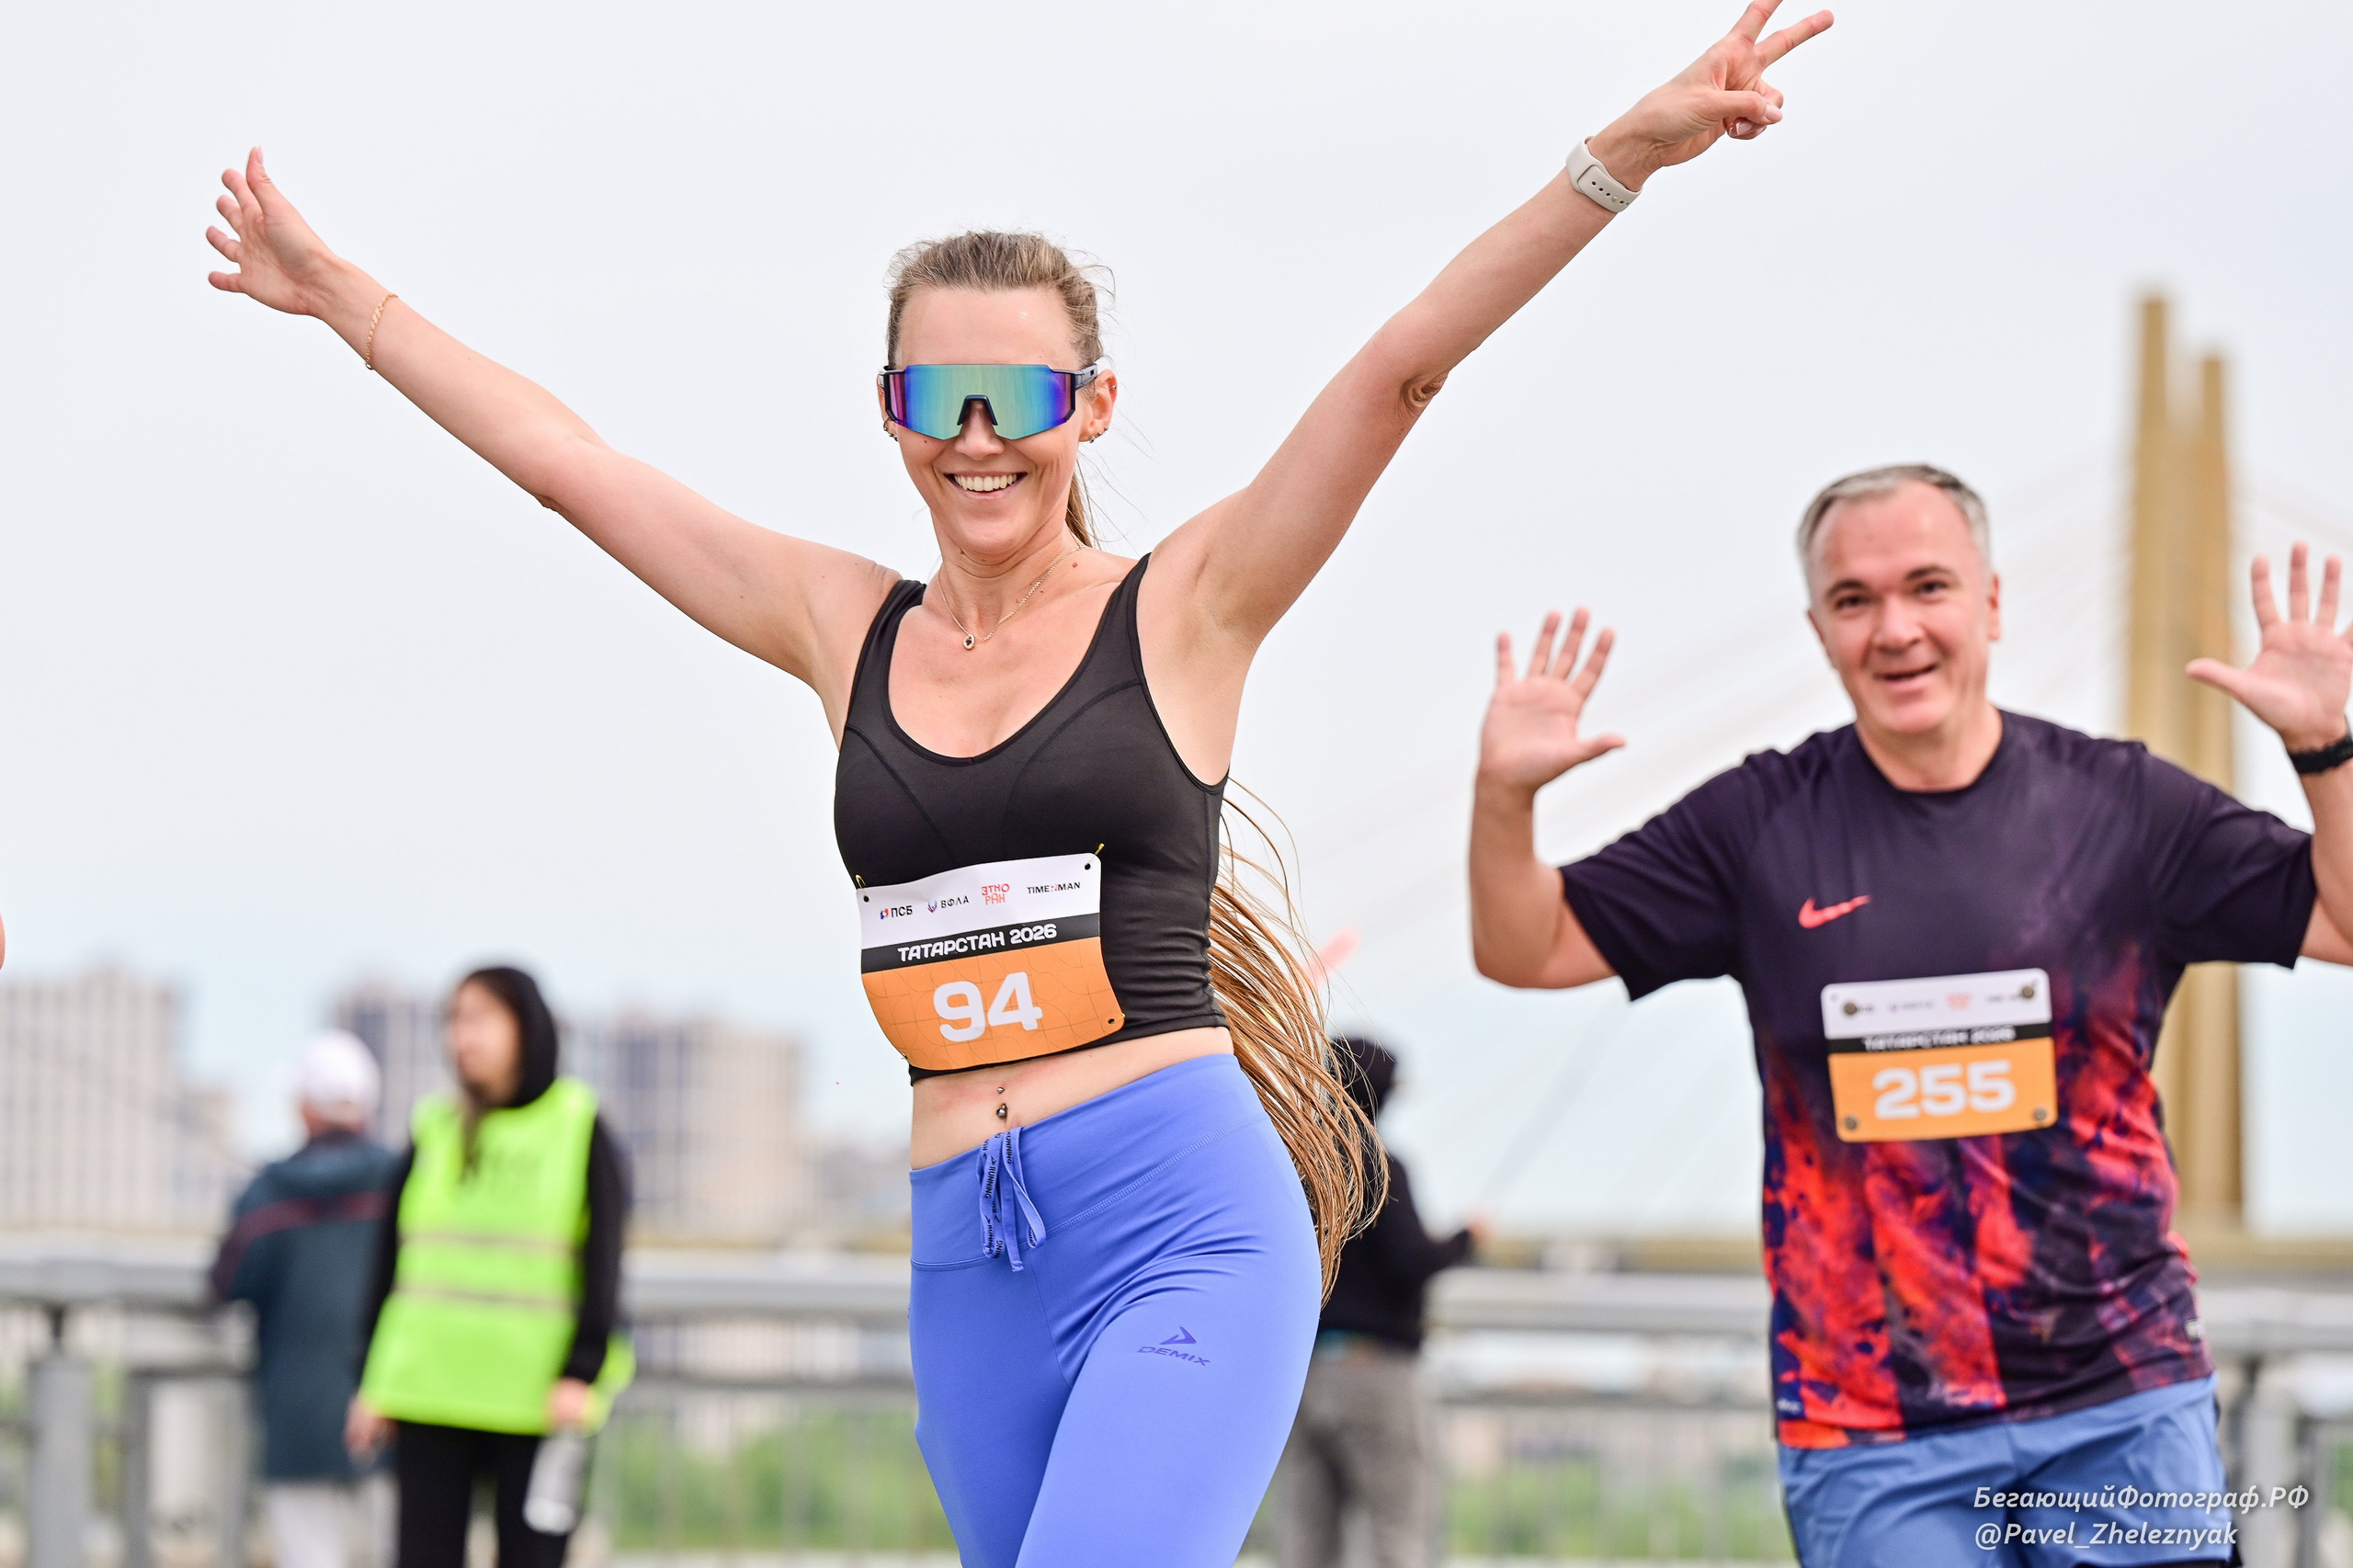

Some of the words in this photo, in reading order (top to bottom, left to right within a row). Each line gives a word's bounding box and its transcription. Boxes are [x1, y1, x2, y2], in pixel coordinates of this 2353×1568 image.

[891, 904, 914, 918] ПСБ
[940, 895, 970, 909] ВФЛА
[897, 931, 1005, 962] ТАТАРСТАН
[1009, 923, 1058, 945] 2026
[933, 971, 1043, 1042] 94
[1871, 1059, 2017, 1119] 255
[984, 1165, 996, 1199] RUNNING
[1137, 1346, 1211, 1367] DEMIX
